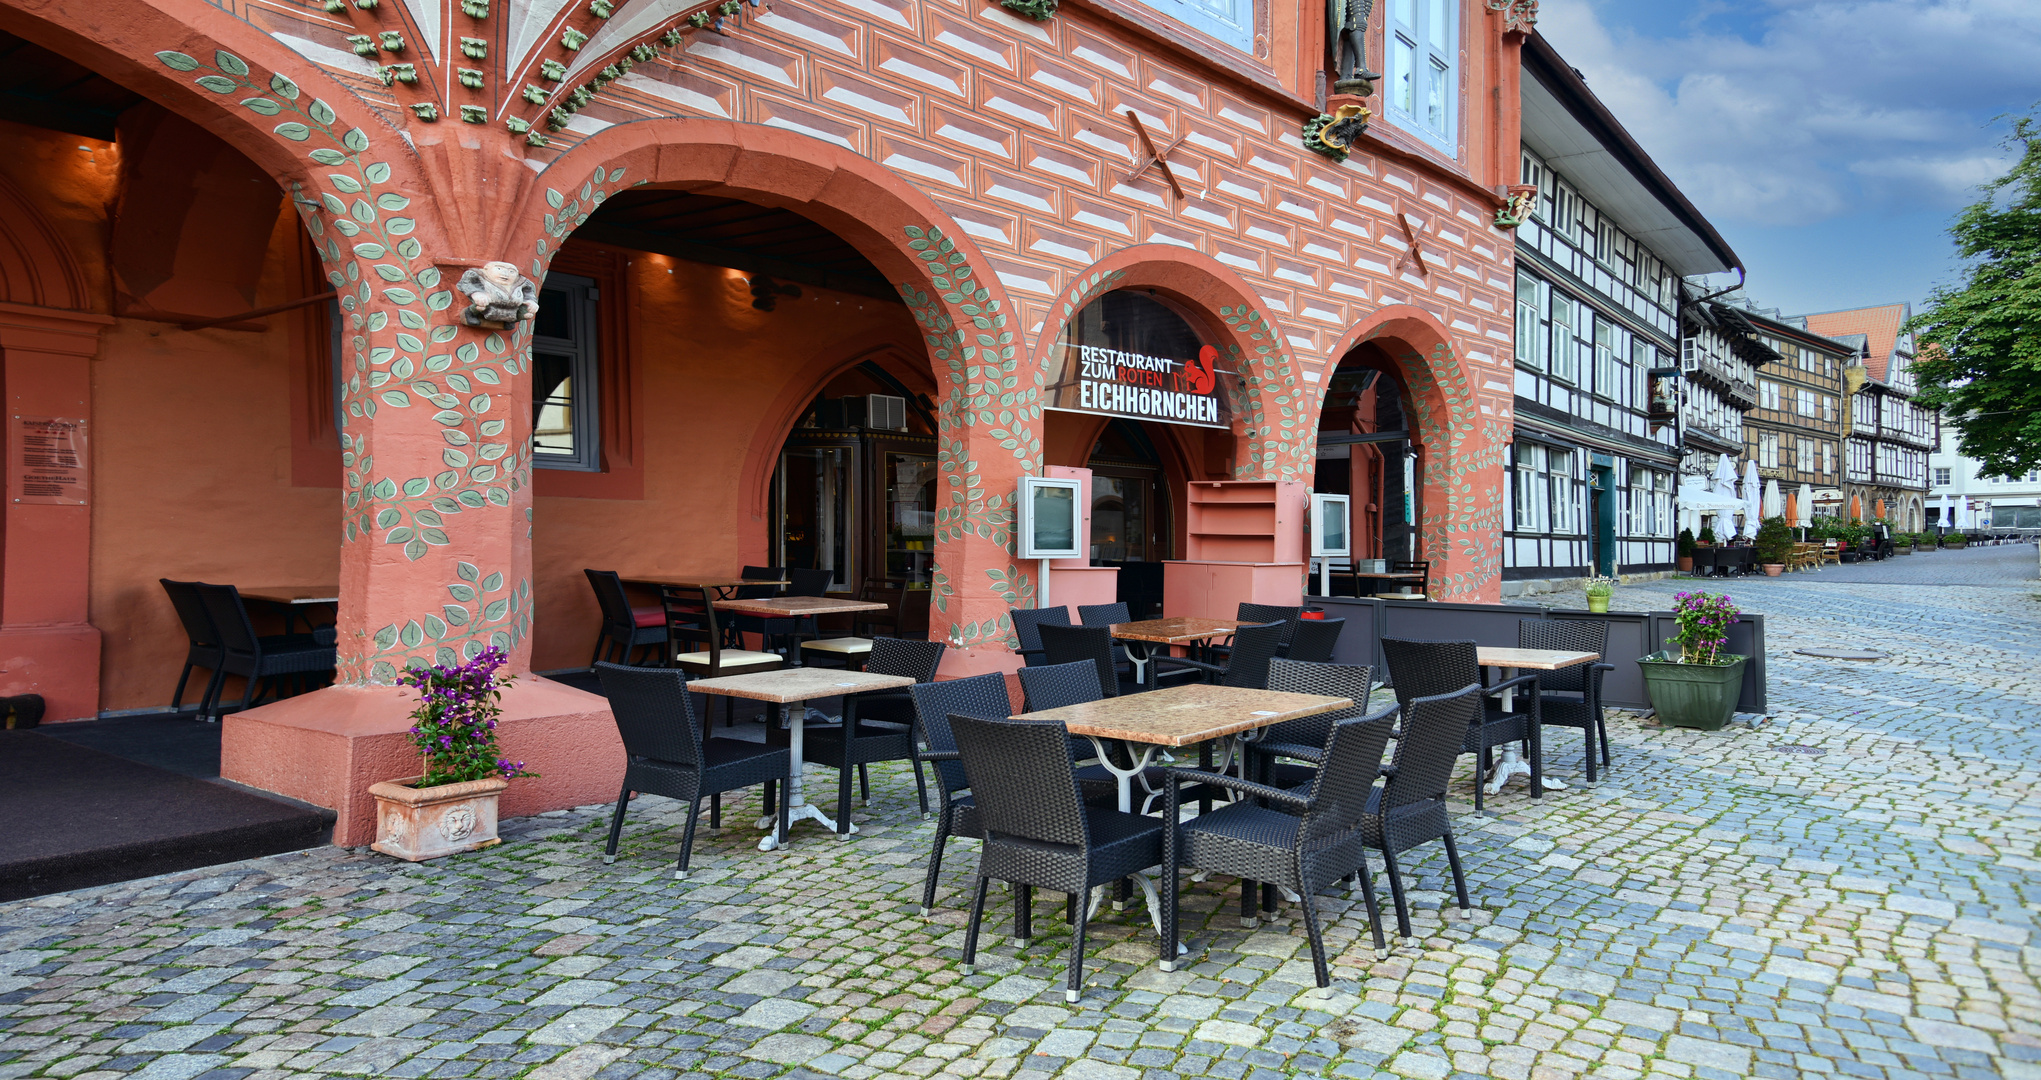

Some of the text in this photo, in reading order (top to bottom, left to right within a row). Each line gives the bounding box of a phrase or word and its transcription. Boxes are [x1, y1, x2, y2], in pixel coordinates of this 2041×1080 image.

[1081, 345, 1172, 373] RESTAURANT
[1081, 361, 1163, 387] ZUM ROTEN
[1081, 380, 1217, 422] EICHHÖRNCHEN
